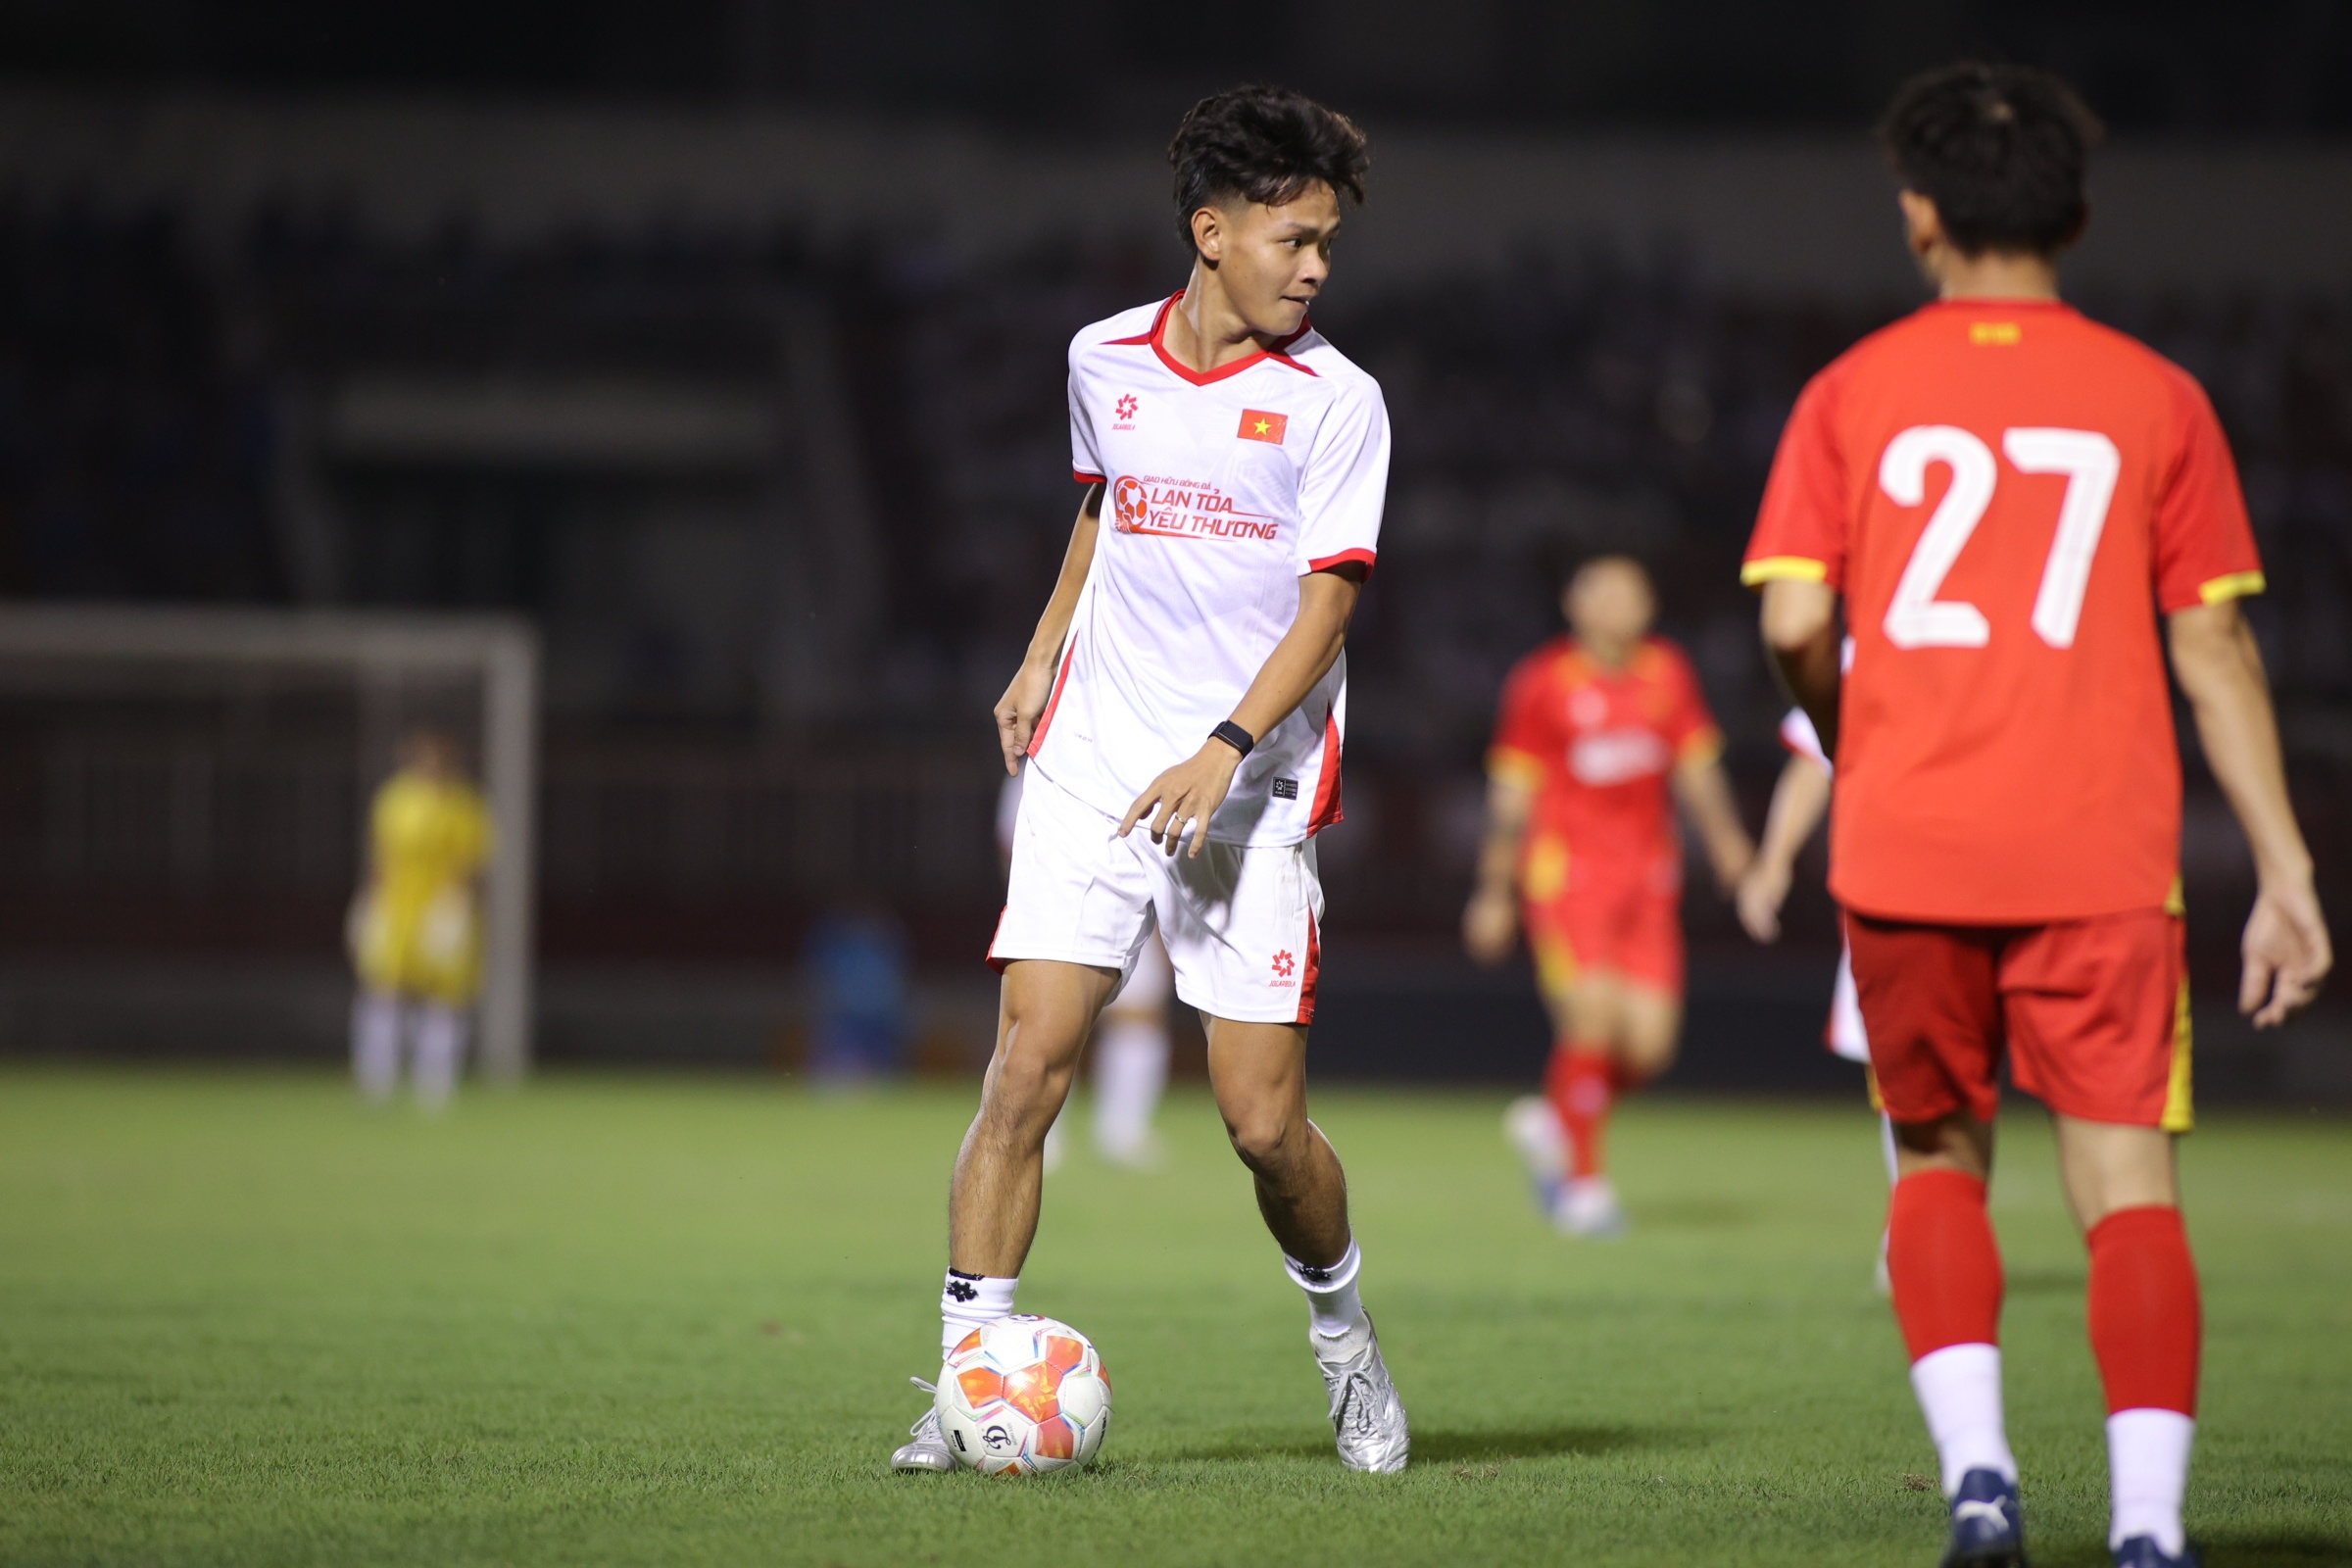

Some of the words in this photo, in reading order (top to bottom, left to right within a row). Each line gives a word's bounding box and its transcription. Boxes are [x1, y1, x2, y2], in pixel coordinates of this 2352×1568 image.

[1143, 474, 1160, 483] GIAO
[1160, 475, 1179, 486] HỮU
[1179, 478, 1200, 489] BÓNG
[1151, 487, 1192, 509] LAN
[1196, 488, 1233, 513] TỎA
[1150, 507, 1188, 530] YÊU
[1191, 515, 1279, 540] THƯƠNG
[1879, 424, 2121, 650] 27
